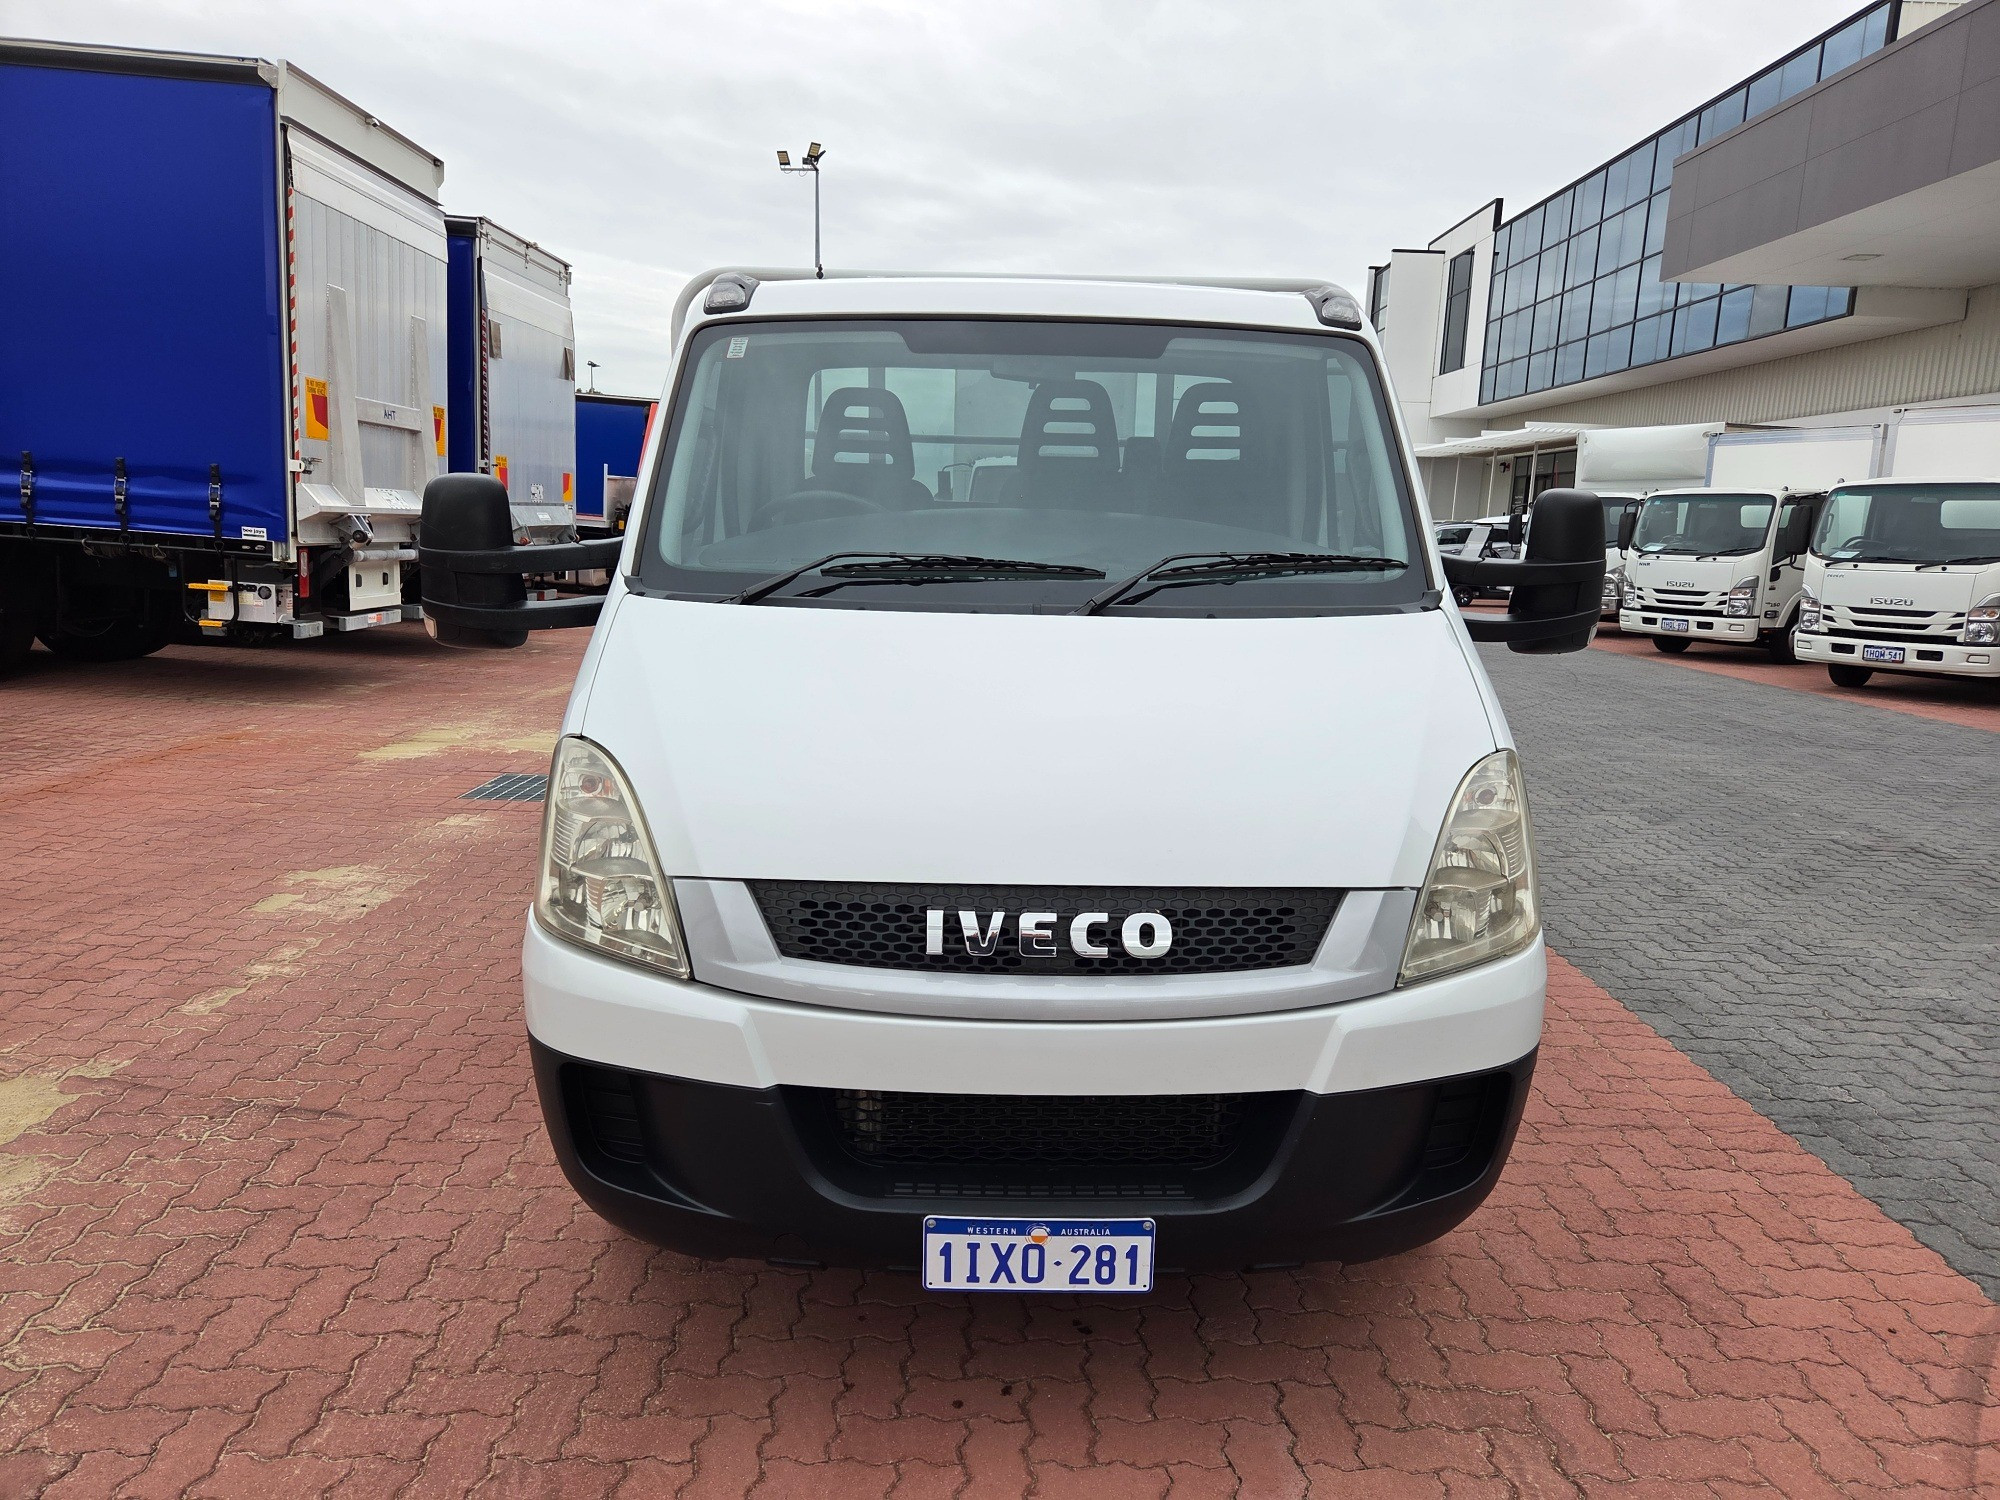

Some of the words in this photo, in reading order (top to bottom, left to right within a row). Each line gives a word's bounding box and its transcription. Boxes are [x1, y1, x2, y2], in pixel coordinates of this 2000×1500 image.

[384, 409, 396, 421] AHT
[1666, 580, 1695, 588] ISUZU
[1870, 597, 1914, 606] ISUZU
[925, 909, 1173, 959] IVECO
[967, 1226, 1017, 1236] WESTERN
[1060, 1228, 1111, 1237] AUSTRALIA
